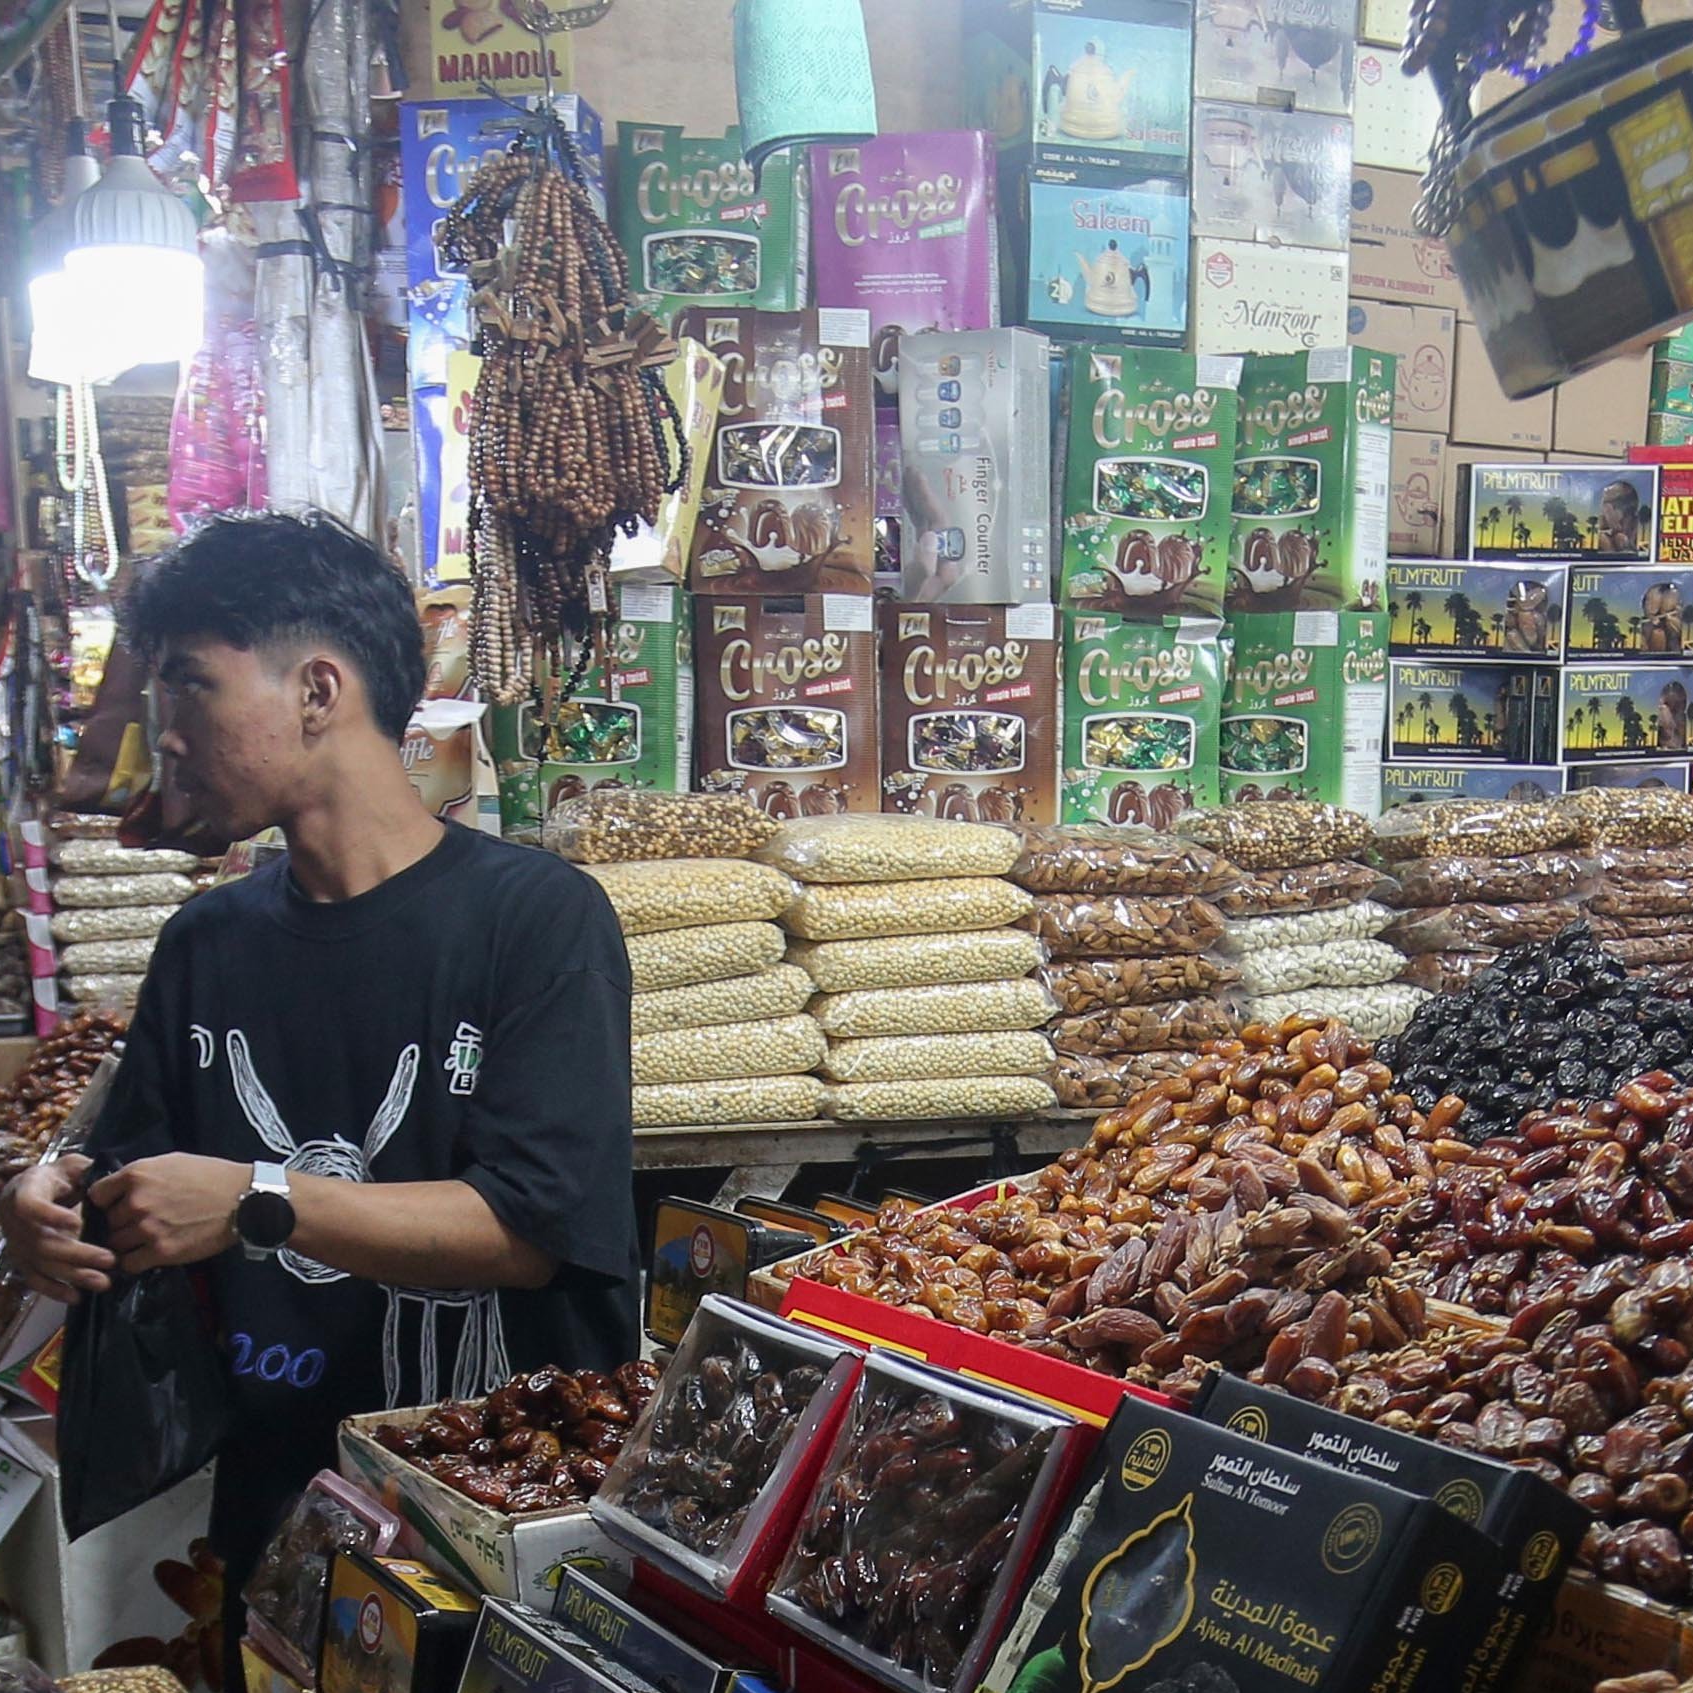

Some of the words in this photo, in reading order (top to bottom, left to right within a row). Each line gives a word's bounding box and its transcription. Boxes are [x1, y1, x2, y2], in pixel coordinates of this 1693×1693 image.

[437, 50, 563, 83] MAAMOUL
[637, 159, 756, 224] Cross
[834, 173, 962, 247] Cross
[1072, 200, 1151, 234] Saleem
[1224, 299, 1322, 341] Manzoor
[1092, 388, 1218, 449] Cross
[975, 455, 991, 506] Finger
[1483, 471, 1562, 490] PALM'FRUTT
[975, 511, 990, 577] Counter
[719, 632, 848, 701] Cross
[903, 640, 1029, 706] Cross
[1079, 644, 1195, 706] Cross
[229, 1332, 326, 1387] 200
[1208, 1450, 1254, 1483] التمور
[1307, 1428, 1354, 1460] التمور
[1348, 1443, 1401, 1473] سلطان
[1201, 1472, 1235, 1498] Sultan
[1235, 1483, 1249, 1500] Al
[1248, 1486, 1290, 1518] Tomoor
[1248, 1469, 1301, 1497] سلطان
[1211, 1579, 1279, 1633] المدينة
[1192, 1615, 1230, 1649] Ajwa
[1232, 1631, 1252, 1655] Al
[1251, 1642, 1320, 1688] Madinah
[1280, 1613, 1337, 1657] عجوة
